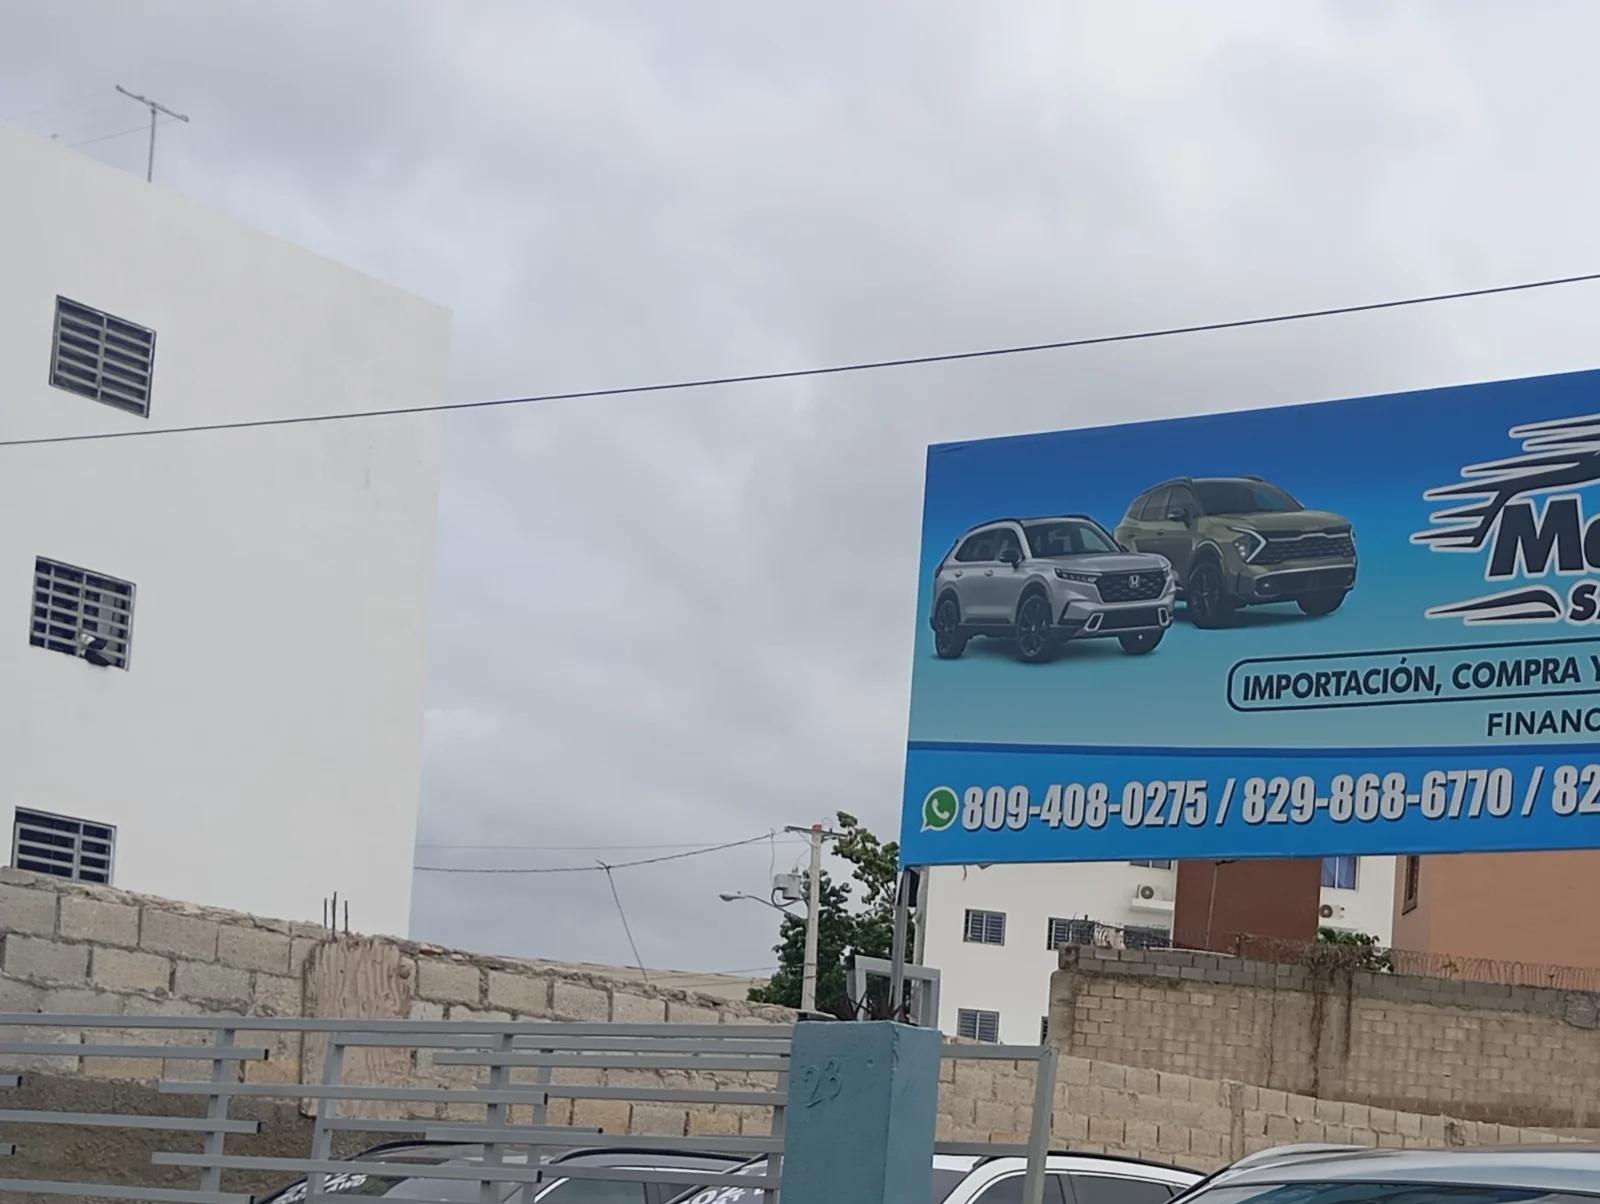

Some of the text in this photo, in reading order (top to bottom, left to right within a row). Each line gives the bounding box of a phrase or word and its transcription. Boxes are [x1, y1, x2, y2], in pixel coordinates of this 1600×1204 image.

[1242, 657, 1443, 701] IMPORTACIÓN,
[1451, 656, 1582, 690] COMPRA
[961, 780, 1208, 831] 809-408-0275
[1242, 767, 1513, 826] 829-868-6770
